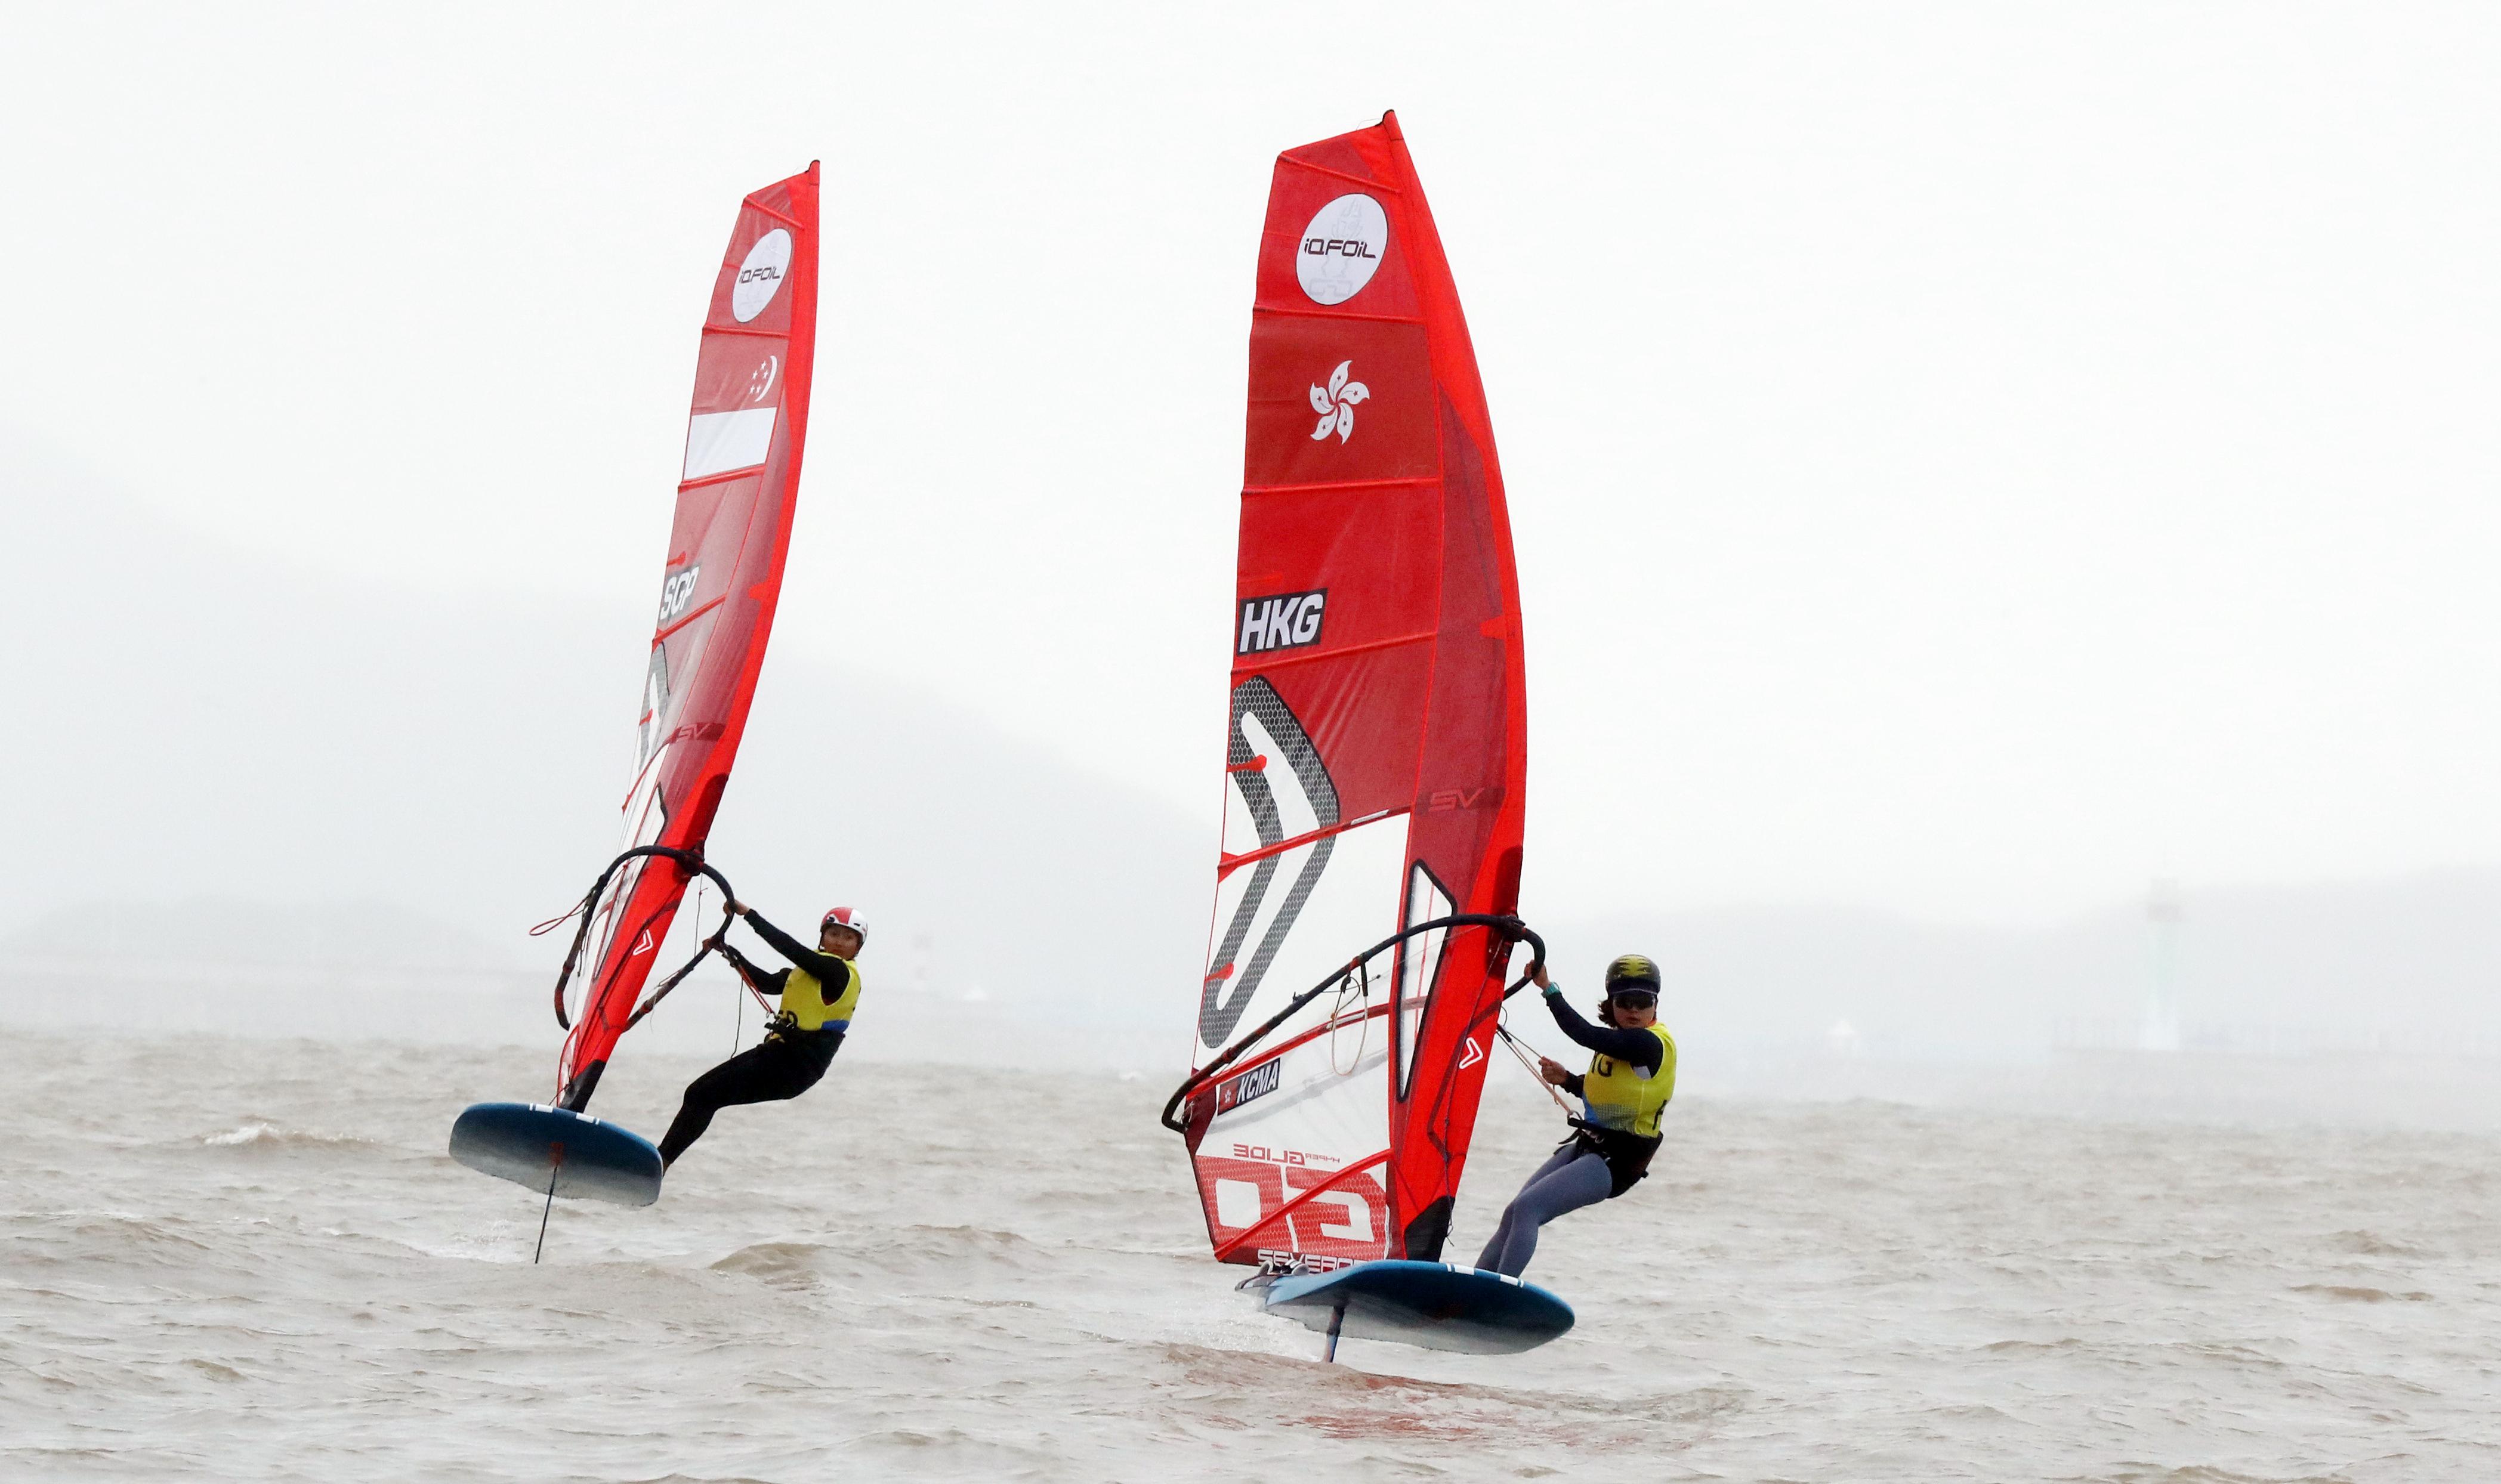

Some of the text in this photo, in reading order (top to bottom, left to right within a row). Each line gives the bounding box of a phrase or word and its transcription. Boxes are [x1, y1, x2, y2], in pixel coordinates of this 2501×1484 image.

[660, 567, 699, 619] SGP
[1239, 593, 1323, 653] HKG
[1429, 788, 1484, 811] SV
[1236, 1061, 1279, 1103] KCMA
